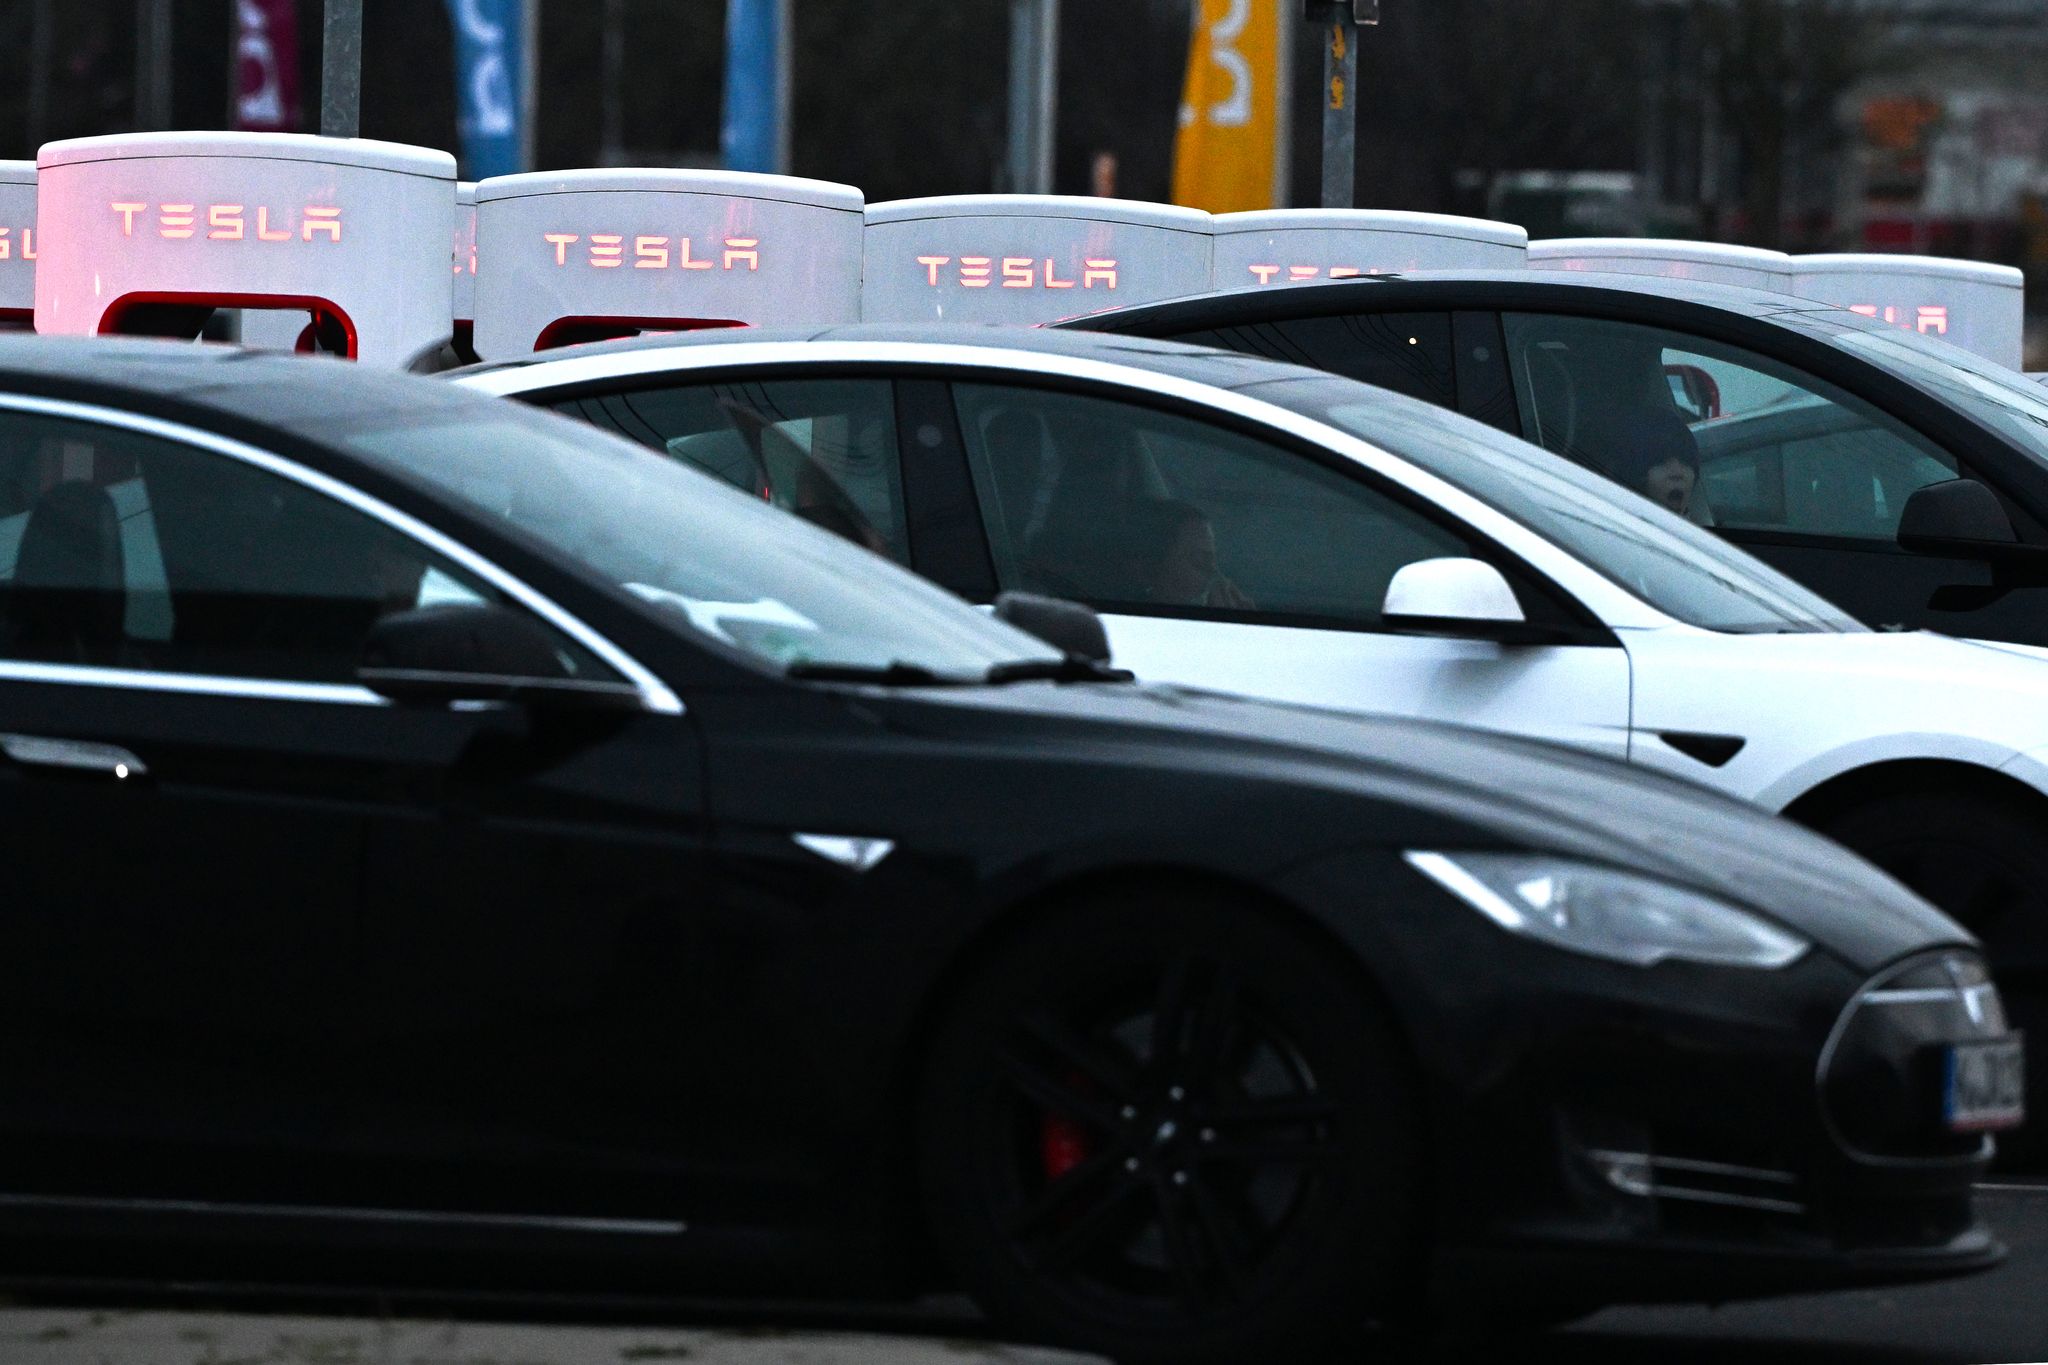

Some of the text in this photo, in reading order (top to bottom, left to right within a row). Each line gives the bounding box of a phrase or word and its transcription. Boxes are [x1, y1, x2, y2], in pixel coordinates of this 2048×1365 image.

[111, 202, 343, 243] TESLA
[544, 233, 760, 271] TESLA
[917, 256, 1118, 290] TESLA
